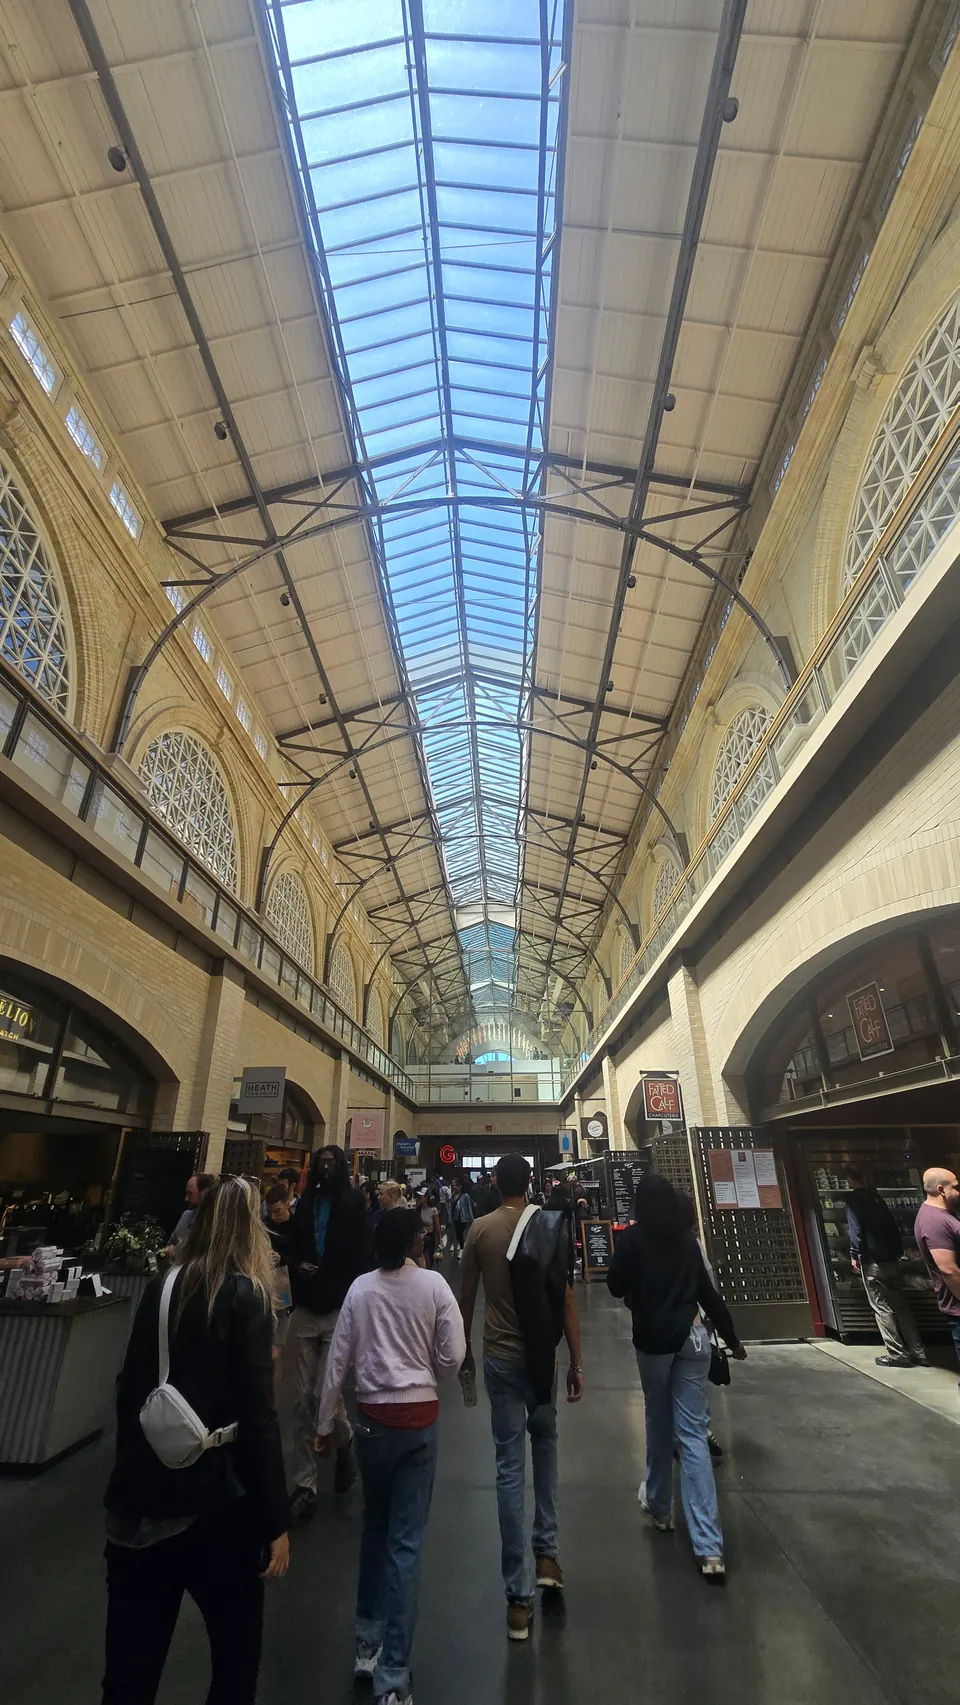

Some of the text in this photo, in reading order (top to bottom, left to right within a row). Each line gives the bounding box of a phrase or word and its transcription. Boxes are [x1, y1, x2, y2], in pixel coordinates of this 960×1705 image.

[247, 1083, 277, 1091] HEATH
[648, 1082, 675, 1095] FATTED
[650, 1095, 674, 1111] CALF
[439, 1144, 456, 1164] G
